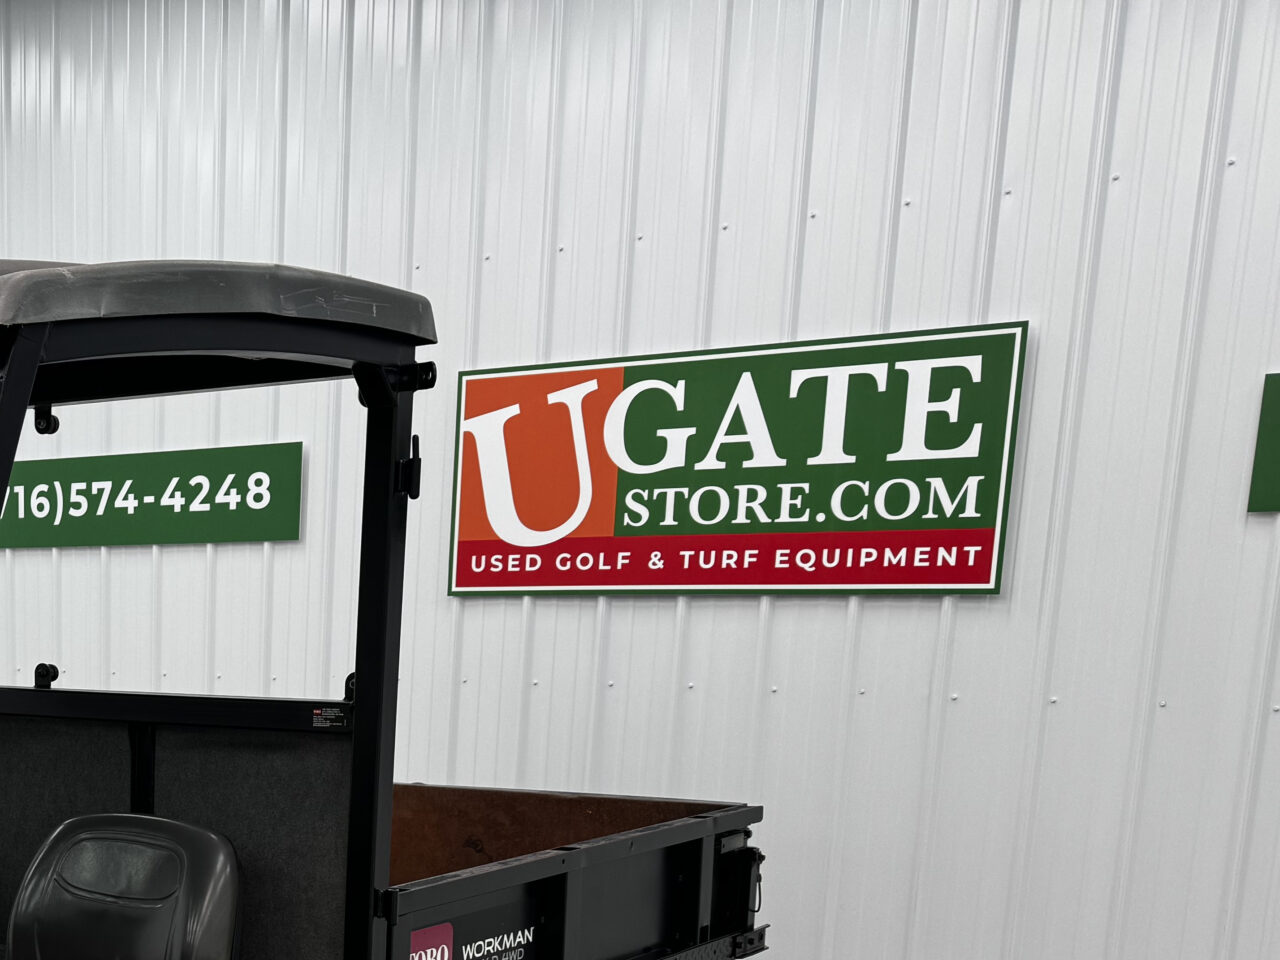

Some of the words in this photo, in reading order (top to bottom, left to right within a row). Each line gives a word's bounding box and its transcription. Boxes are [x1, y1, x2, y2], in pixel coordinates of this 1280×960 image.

[463, 354, 983, 547] UGATE
[623, 476, 985, 527] STORE.COM
[471, 553, 542, 572] USED
[556, 551, 631, 571] GOLF
[648, 551, 666, 570] &
[680, 549, 759, 569] TURF
[775, 545, 982, 572] EQUIPMENT
[462, 926, 534, 960] WORKMAN
